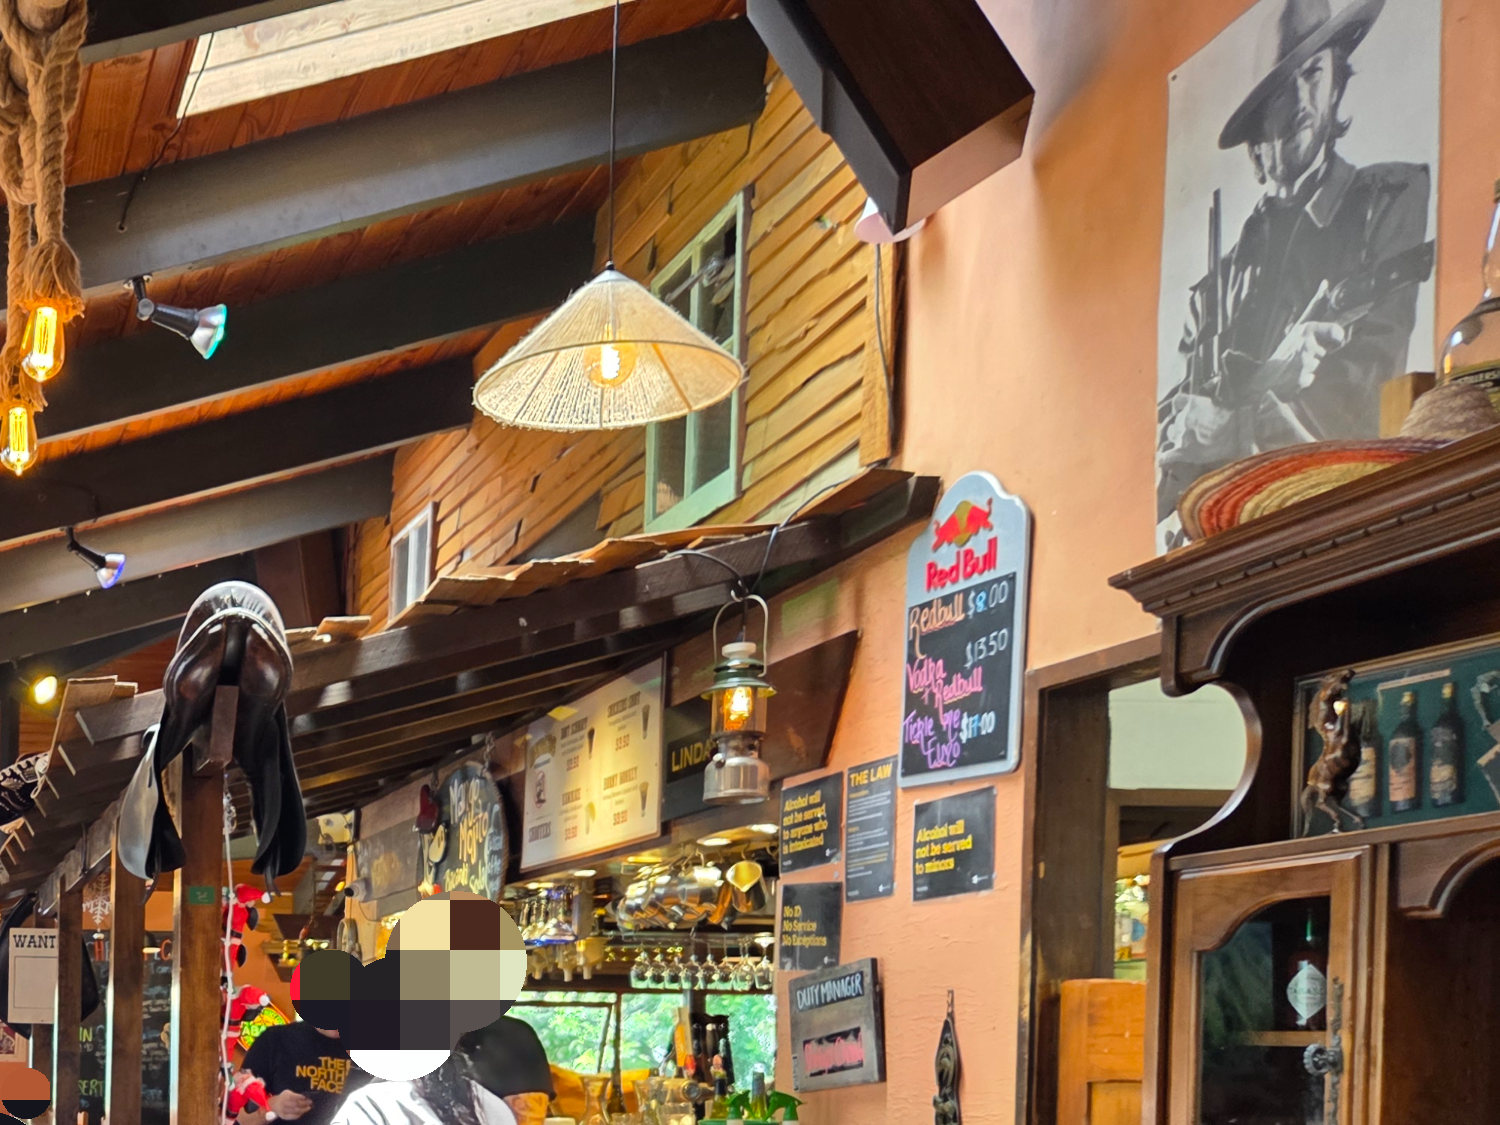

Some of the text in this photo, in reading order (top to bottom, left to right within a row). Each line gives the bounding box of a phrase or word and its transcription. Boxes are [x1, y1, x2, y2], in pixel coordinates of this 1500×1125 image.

[926, 537, 998, 592] Red Bull
[909, 580, 1009, 656] Redbull $8.00
[906, 657, 947, 694] Vodka
[850, 762, 893, 787] THE LAW
[784, 794, 808, 812] Alcohol
[916, 819, 965, 843] Alcohol will
[915, 834, 972, 859] not be served
[915, 857, 955, 875] to minors
[783, 905, 802, 917] No ID
[783, 920, 817, 931] No Service
[13, 934, 57, 948] WANT
[782, 934, 827, 948] No Exceptions
[797, 972, 863, 1009] DUTY MANAGER
[318, 1056, 346, 1070] THE
[295, 1065, 345, 1081] NORTH
[310, 1077, 345, 1094] FACE
